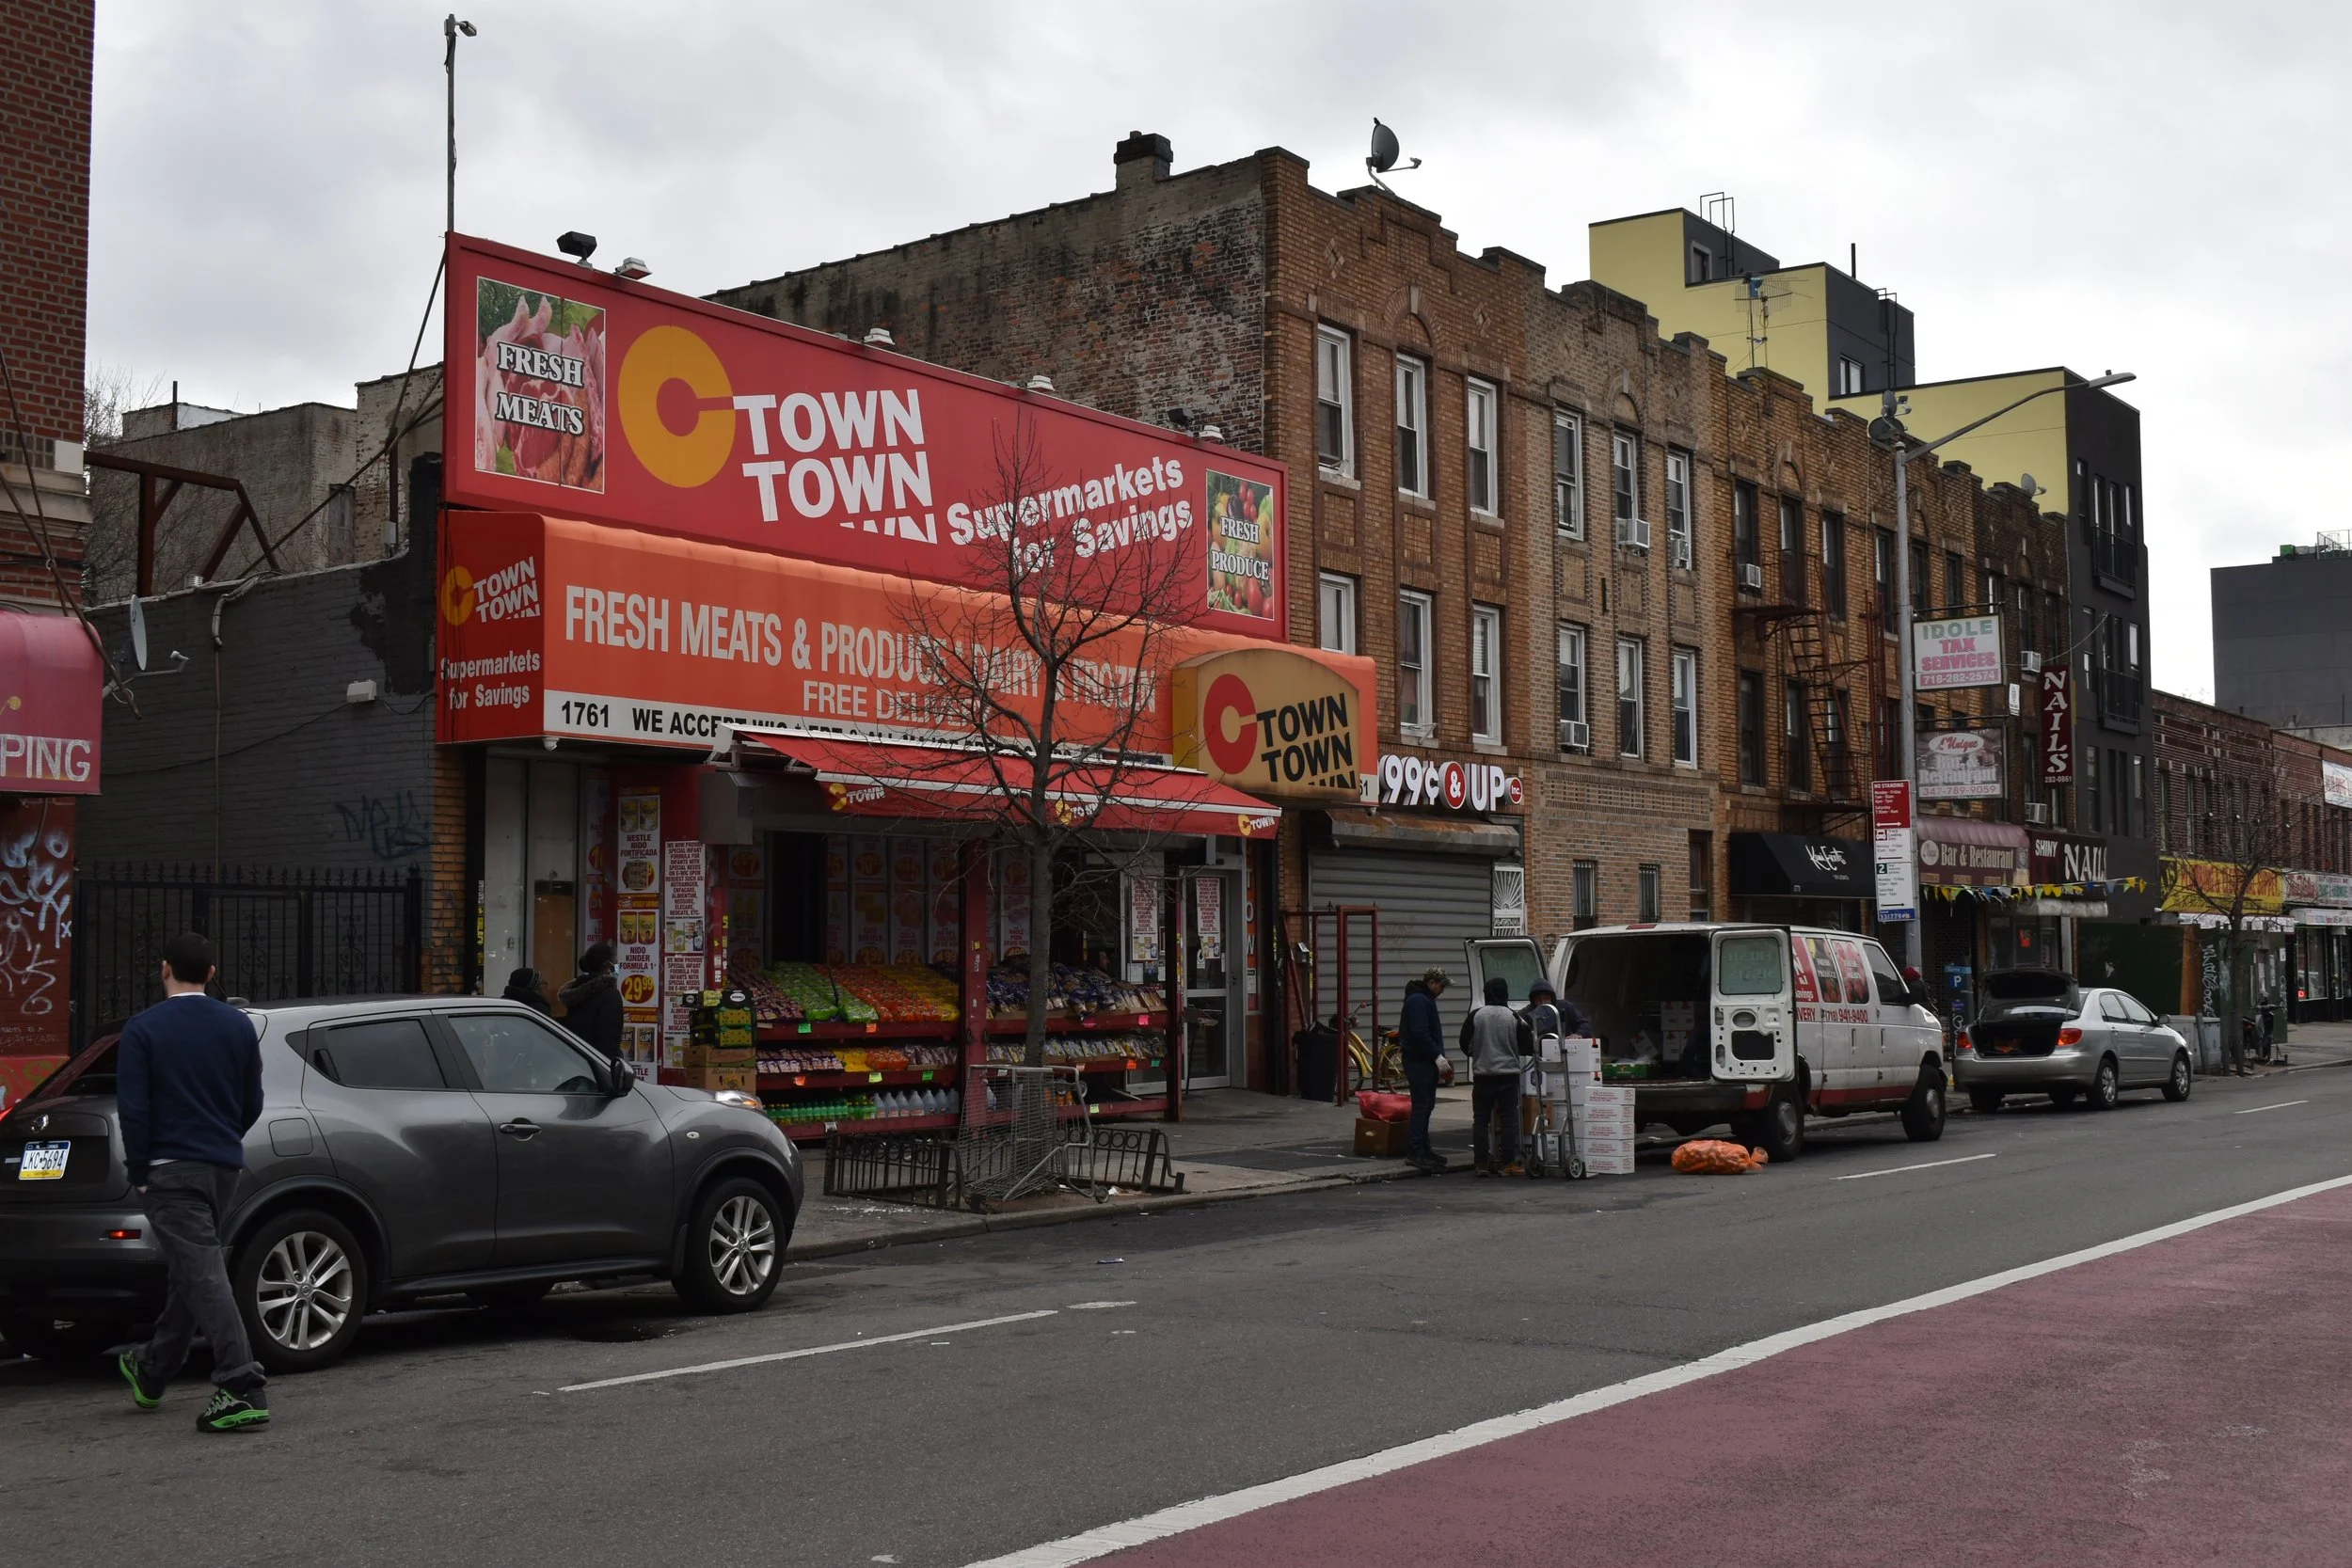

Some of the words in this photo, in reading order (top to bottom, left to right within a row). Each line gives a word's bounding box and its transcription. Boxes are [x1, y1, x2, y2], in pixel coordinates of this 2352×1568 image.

[497, 341, 583, 388] FRESH
[496, 391, 583, 436] MEATS
[733, 388, 925, 454] TOWN
[742, 451, 933, 522] TOWN
[946, 456, 1184, 546] Supermarkets
[1012, 536, 1056, 577] for
[1072, 499, 1194, 559] Savings
[1220, 515, 1260, 544] FRESH
[473, 556, 535, 603] TOWN
[1211, 550, 1269, 580] PRODUCE
[476, 580, 539, 623] TOWN
[1923, 620, 1993, 640] IDOLE
[566, 584, 669, 653] FRESH
[681, 602, 781, 666] MEATS
[791, 618, 812, 671] &
[820, 621, 947, 687] PRODUCE
[972, 643, 1041, 698] DAIRY
[1073, 657, 1156, 713] FROZEN
[1939, 637, 1976, 654] TAX
[440, 649, 540, 682] Supermarkets
[1921, 651, 1995, 672] SERVICES
[1924, 670, 1995, 685] 718-282-2574
[450, 688, 469, 710] for
[475, 683, 530, 709] Savings
[803, 680, 867, 718] FREE
[877, 689, 992, 728] DELIVERY
[562, 700, 609, 728] 1761
[632, 707, 662, 733] WE
[1257, 692, 1348, 748] TOWN
[2044, 670, 2069, 773] NAILS
[0, 734, 91, 782] PING
[1262, 732, 1353, 783] TOWN
[1936, 754, 1963, 770] Bar
[1965, 753, 1979, 769] &
[1382, 754, 1439, 807] 99¢
[1450, 770, 1461, 799] &
[1470, 763, 1505, 812] UP
[1511, 784, 1521, 796] Inc.
[1919, 766, 1996, 785] Restaurant
[1923, 784, 1995, 796] 347-789-9059
[847, 786, 885, 804] TOWN
[1250, 816, 1276, 831] TOWN
[1941, 844, 1958, 866] Bar
[1960, 844, 1968, 867] &
[1969, 846, 2013, 869] Restaurant
[2035, 838, 2058, 858] SHINY
[1878, 863, 1885, 874] 2
